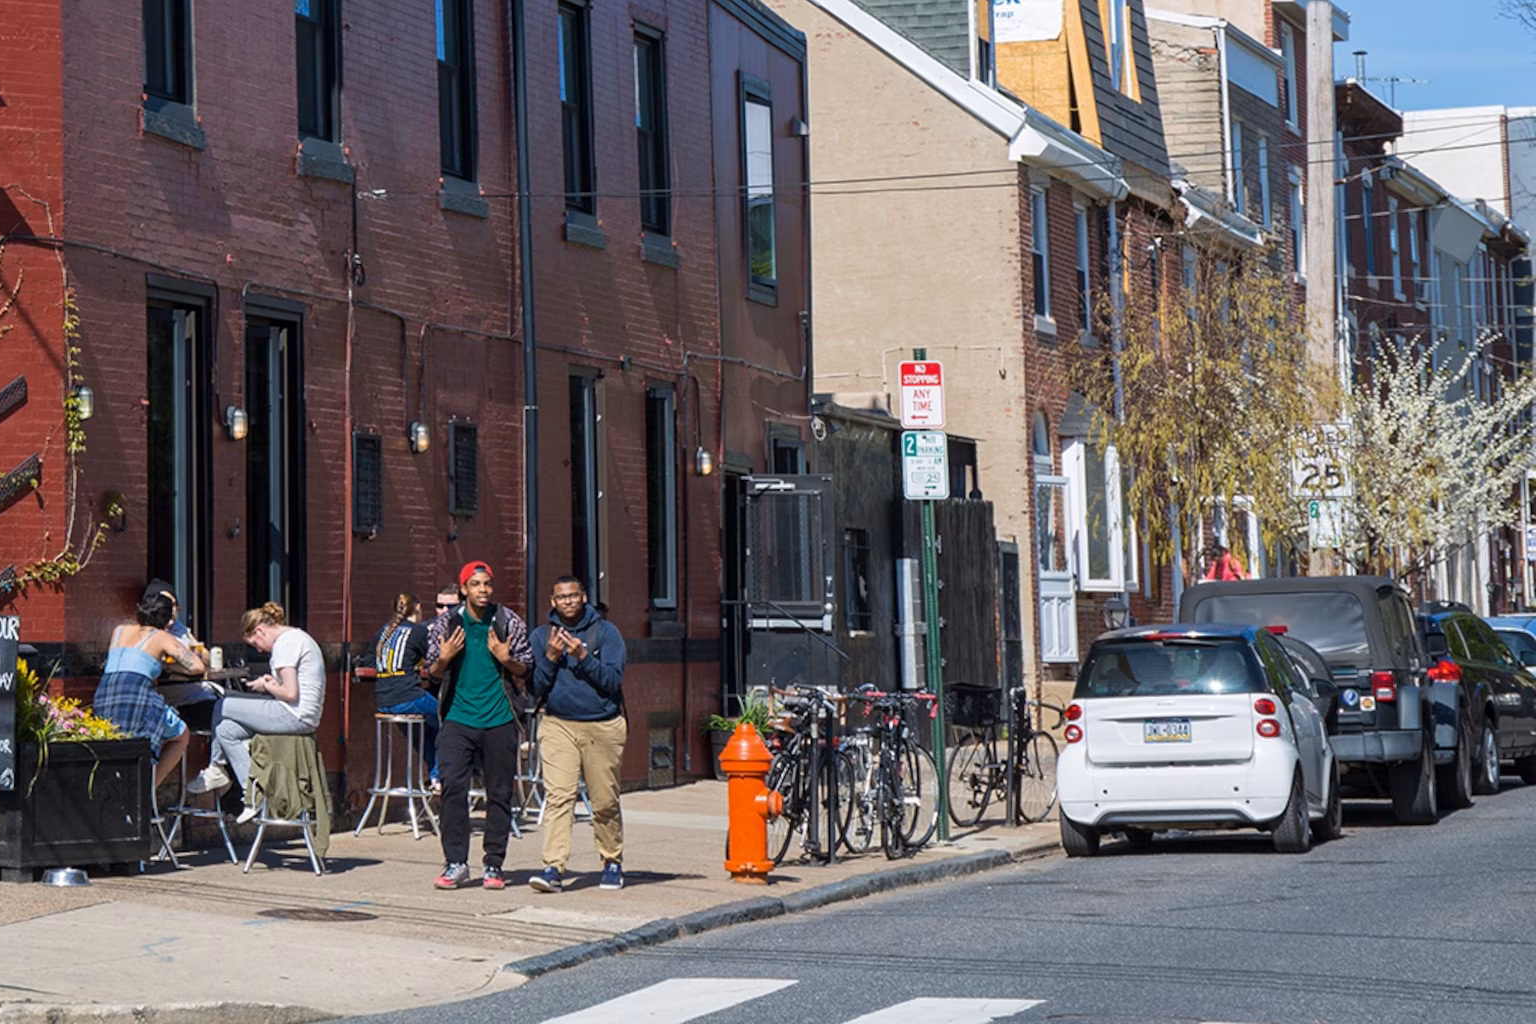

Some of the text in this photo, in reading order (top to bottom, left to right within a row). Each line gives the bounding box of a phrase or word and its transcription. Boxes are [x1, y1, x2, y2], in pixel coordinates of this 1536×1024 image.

[915, 364, 926, 373] NO
[903, 374, 939, 385] STOPPING
[913, 389, 931, 399] ANY
[912, 401, 933, 412] TIME
[906, 436, 915, 454] 2
[1301, 465, 1341, 489] 25
